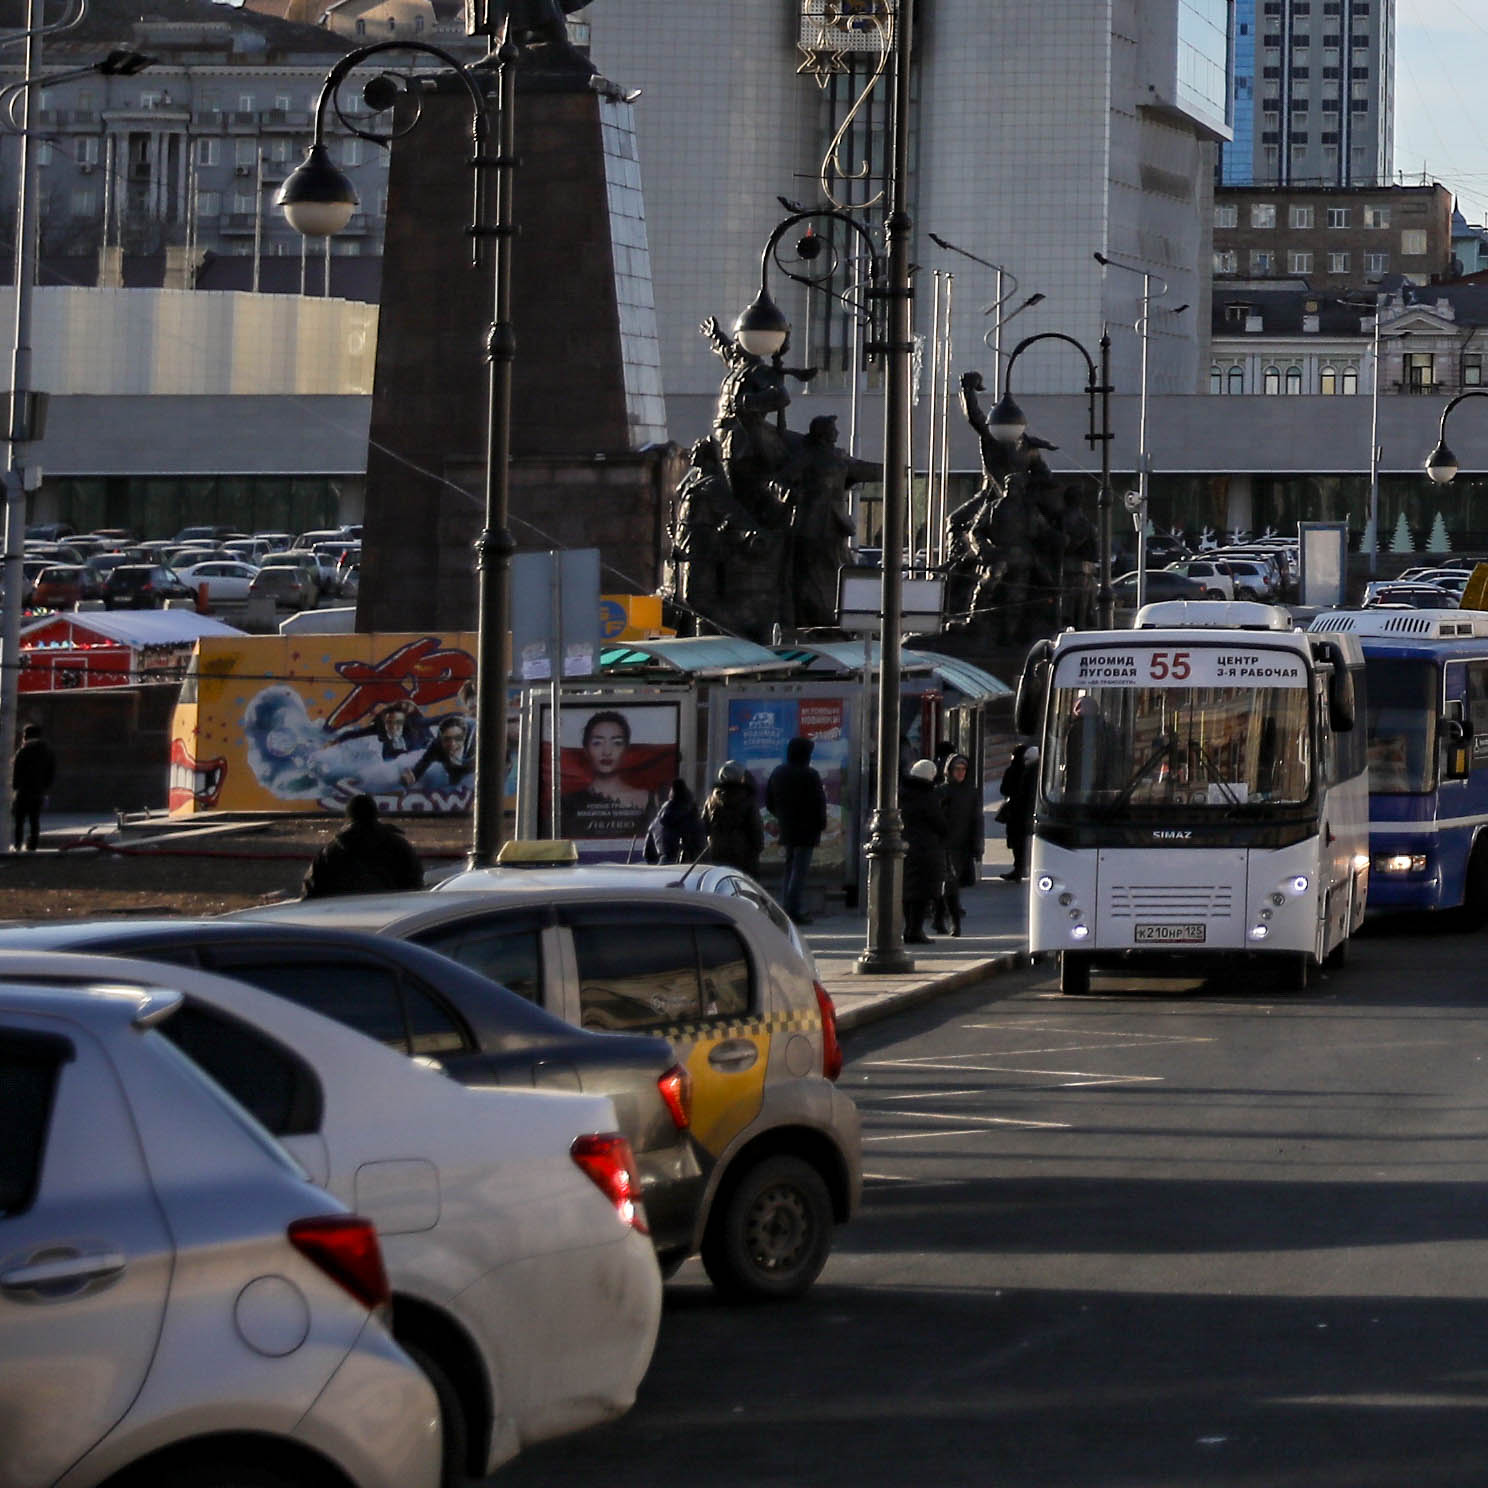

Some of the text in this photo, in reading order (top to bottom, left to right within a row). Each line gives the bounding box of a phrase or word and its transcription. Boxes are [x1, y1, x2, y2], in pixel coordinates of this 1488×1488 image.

[1079, 656, 1134, 667] ДИОМИД
[1217, 656, 1259, 666] ЦЕНТР
[1150, 652, 1191, 681] 55
[1079, 668, 1137, 678] ЛУГОВАЯ
[1240, 669, 1298, 678] РАБОЧАЯ
[1152, 831, 1193, 839] SIMAZ
[1138, 926, 1202, 939] К210НР 125
